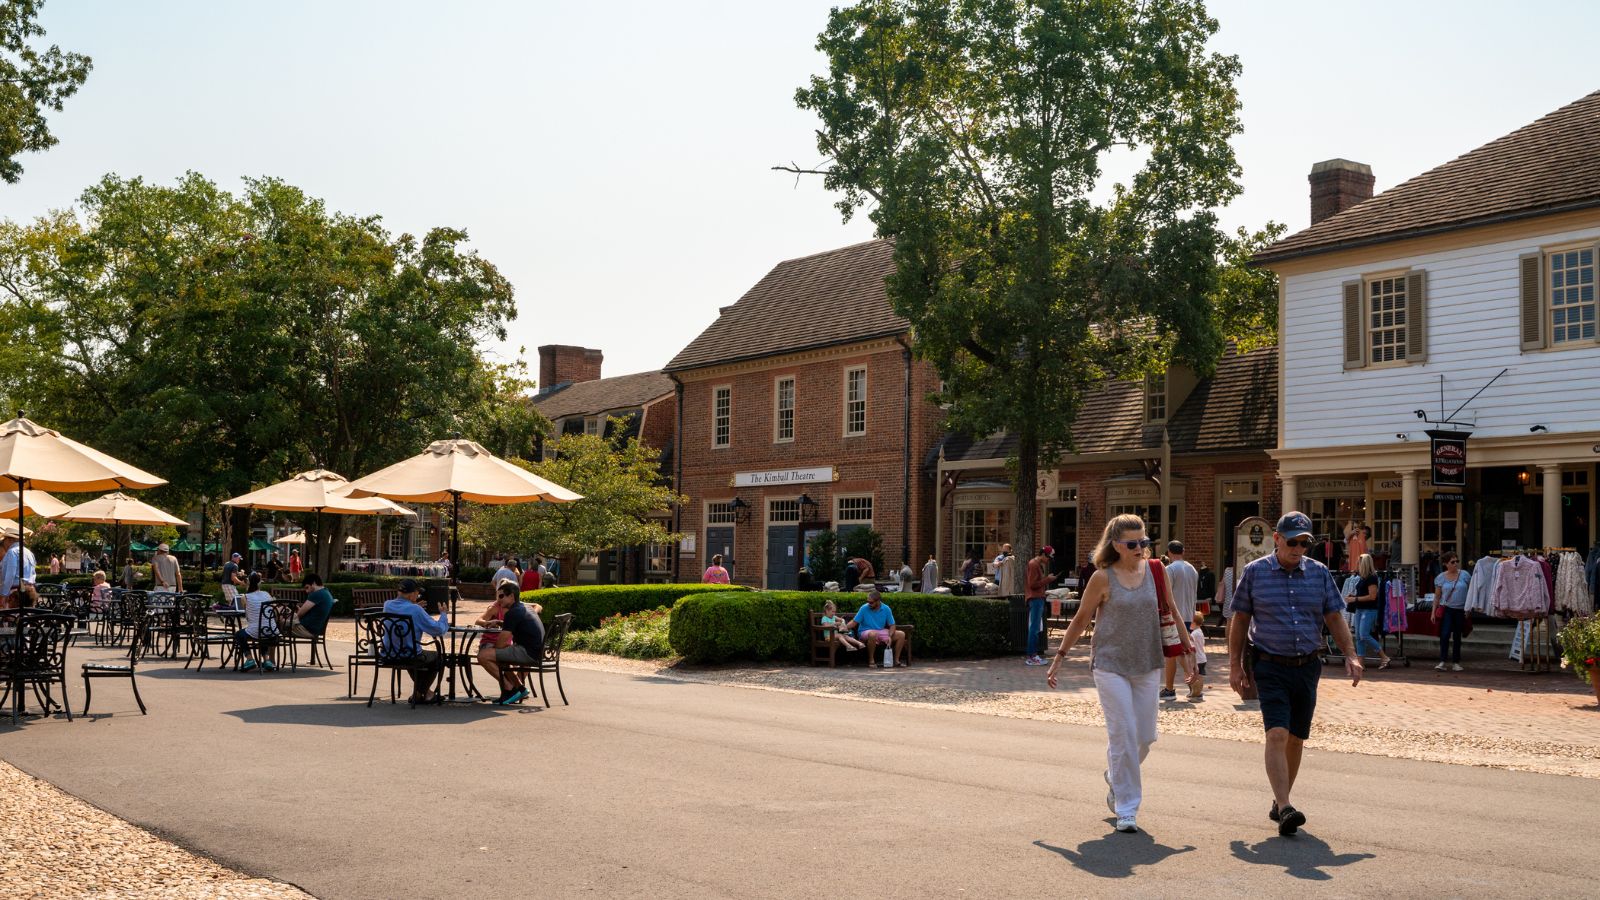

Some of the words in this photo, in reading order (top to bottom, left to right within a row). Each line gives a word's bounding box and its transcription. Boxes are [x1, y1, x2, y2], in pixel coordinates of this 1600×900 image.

[1436, 444, 1463, 458] GENERAL
[750, 473, 762, 484] The
[764, 471, 789, 483] Kimball
[791, 470, 816, 481] Theatre
[1381, 479, 1402, 489] GENE
